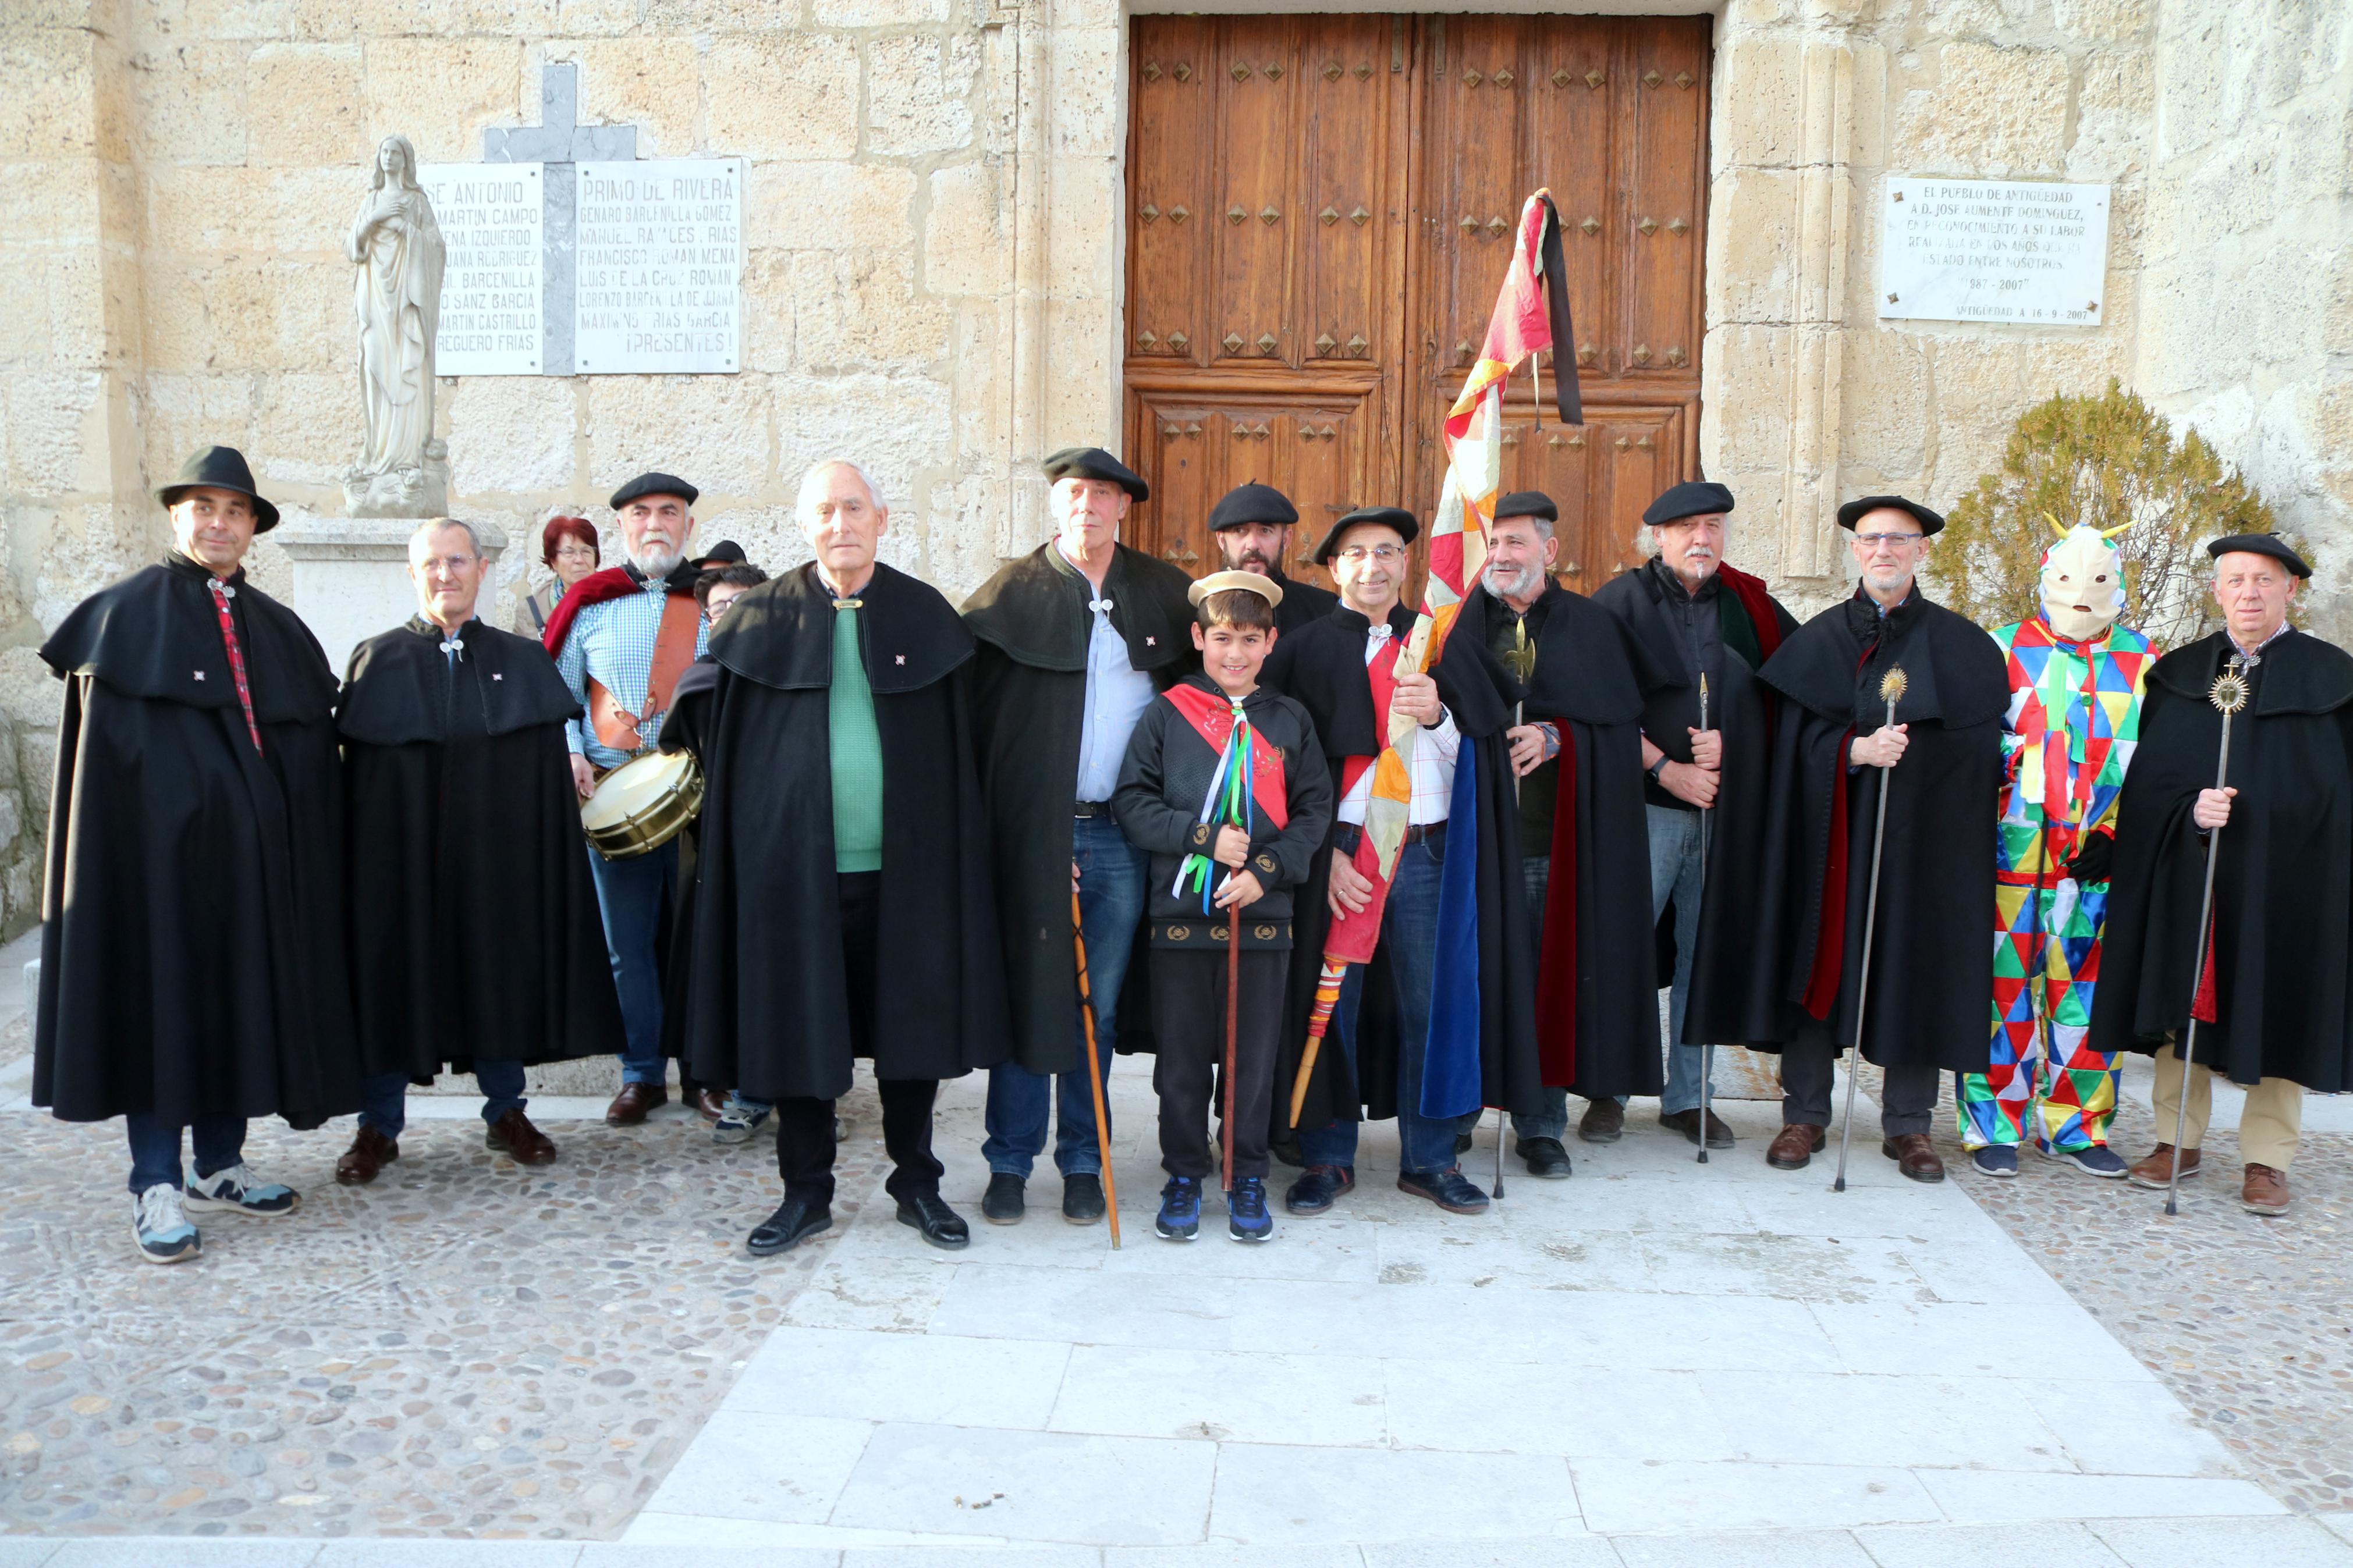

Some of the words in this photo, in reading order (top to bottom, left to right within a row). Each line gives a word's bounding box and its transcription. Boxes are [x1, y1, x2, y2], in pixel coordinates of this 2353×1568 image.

[454, 182, 523, 204] ANTONIO
[584, 179, 634, 202] PRIMO
[643, 179, 665, 201] DE
[673, 178, 733, 201] RIVERA
[1924, 187, 1936, 197] EL
[1941, 187, 1982, 199] PUEBLO
[1988, 189, 2001, 200] DE
[2004, 189, 2072, 203] ANTIGÜEDAD
[438, 209, 487, 226] MARTIN
[493, 208, 537, 225] CAMPO
[580, 207, 621, 223] GENARO
[626, 205, 691, 222] BARCENILLA
[696, 205, 732, 221] GOMEZ
[1911, 204, 1917, 214] A
[1922, 204, 1932, 214] D.
[1965, 205, 2013, 217] AUMENTE
[580, 228, 631, 245] MANUEL
[1907, 220, 1919, 231] EN
[1925, 221, 2018, 234] RECONOCIMIENTO
[2022, 224, 2029, 235] A
[2033, 225, 2047, 235] SU
[2050, 225, 2085, 237] LABOR
[441, 230, 466, 247] ENA
[472, 229, 530, 247] IZQUIERDO
[2011, 238, 2039, 253] AÑOS
[478, 250, 537, 267] RODRIGUEZ
[580, 249, 647, 266] FRANCISCO
[652, 248, 695, 265] ROMAN
[702, 248, 735, 265] MENA
[1922, 254, 1964, 265] ESTADO
[1969, 255, 2002, 268] ENTRE
[463, 272, 534, 288] BARCENILLA
[580, 271, 606, 287] LUIS
[612, 270, 627, 287] DE
[632, 270, 647, 286] LA
[652, 270, 684, 286] CRUZ
[690, 269, 731, 286] ROMAN
[454, 294, 486, 310] SANZ
[492, 293, 534, 309] GARCIA
[580, 291, 621, 308] LORENZO
[687, 291, 699, 307] DE
[704, 290, 734, 307] JUANA
[687, 311, 730, 328] GARCIA
[1956, 304, 2013, 317] ANTIGÜEDAD
[2019, 308, 2025, 317] A
[2032, 309, 2042, 318] 16
[2052, 310, 2057, 318] 9
[2067, 310, 2088, 319] 2007
[438, 315, 474, 332] MARTIN
[478, 314, 535, 330] CASTRILLO
[438, 335, 492, 351] REGUERO
[499, 335, 534, 351] FRIAS
[627, 333, 732, 353] ¡PRESENTES!
